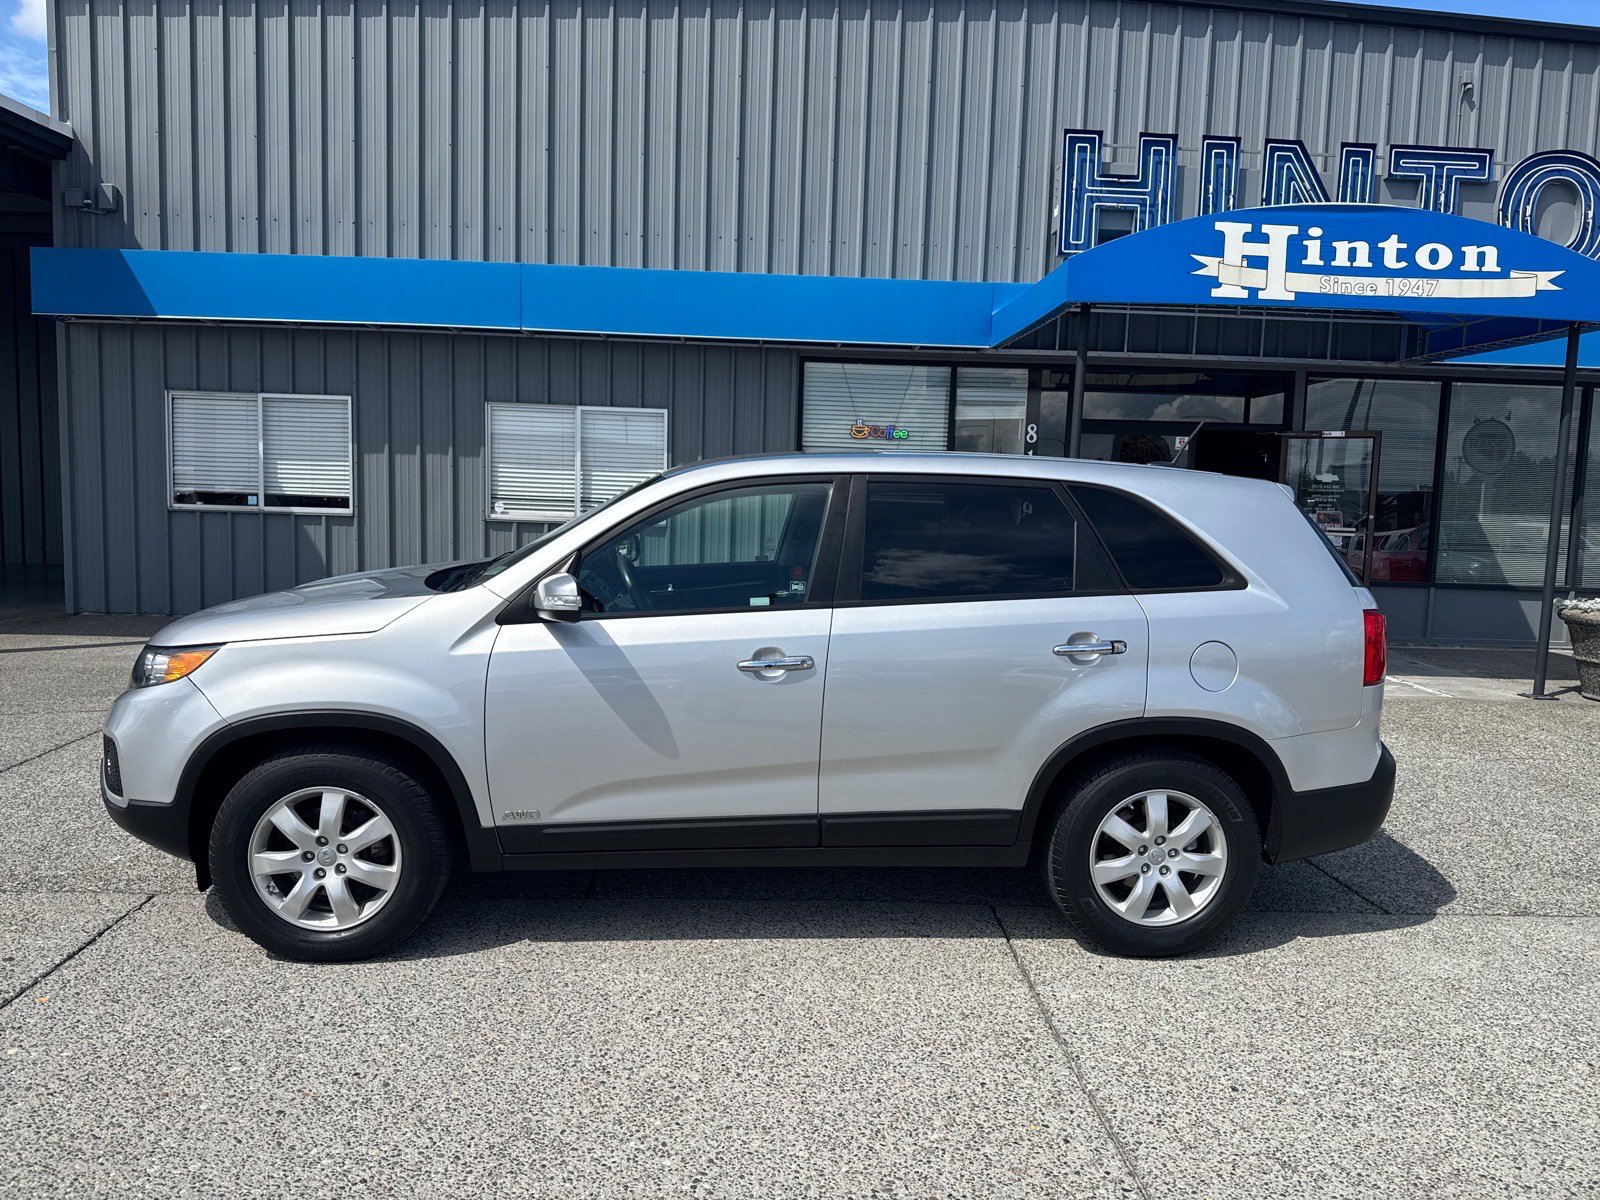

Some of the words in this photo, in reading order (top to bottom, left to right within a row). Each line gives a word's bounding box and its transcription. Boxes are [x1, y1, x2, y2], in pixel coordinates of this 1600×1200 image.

[1210, 221, 1502, 301] Hinton
[1320, 275, 1378, 295] Since
[1386, 279, 1440, 297] 1947
[870, 424, 909, 440] Coffee
